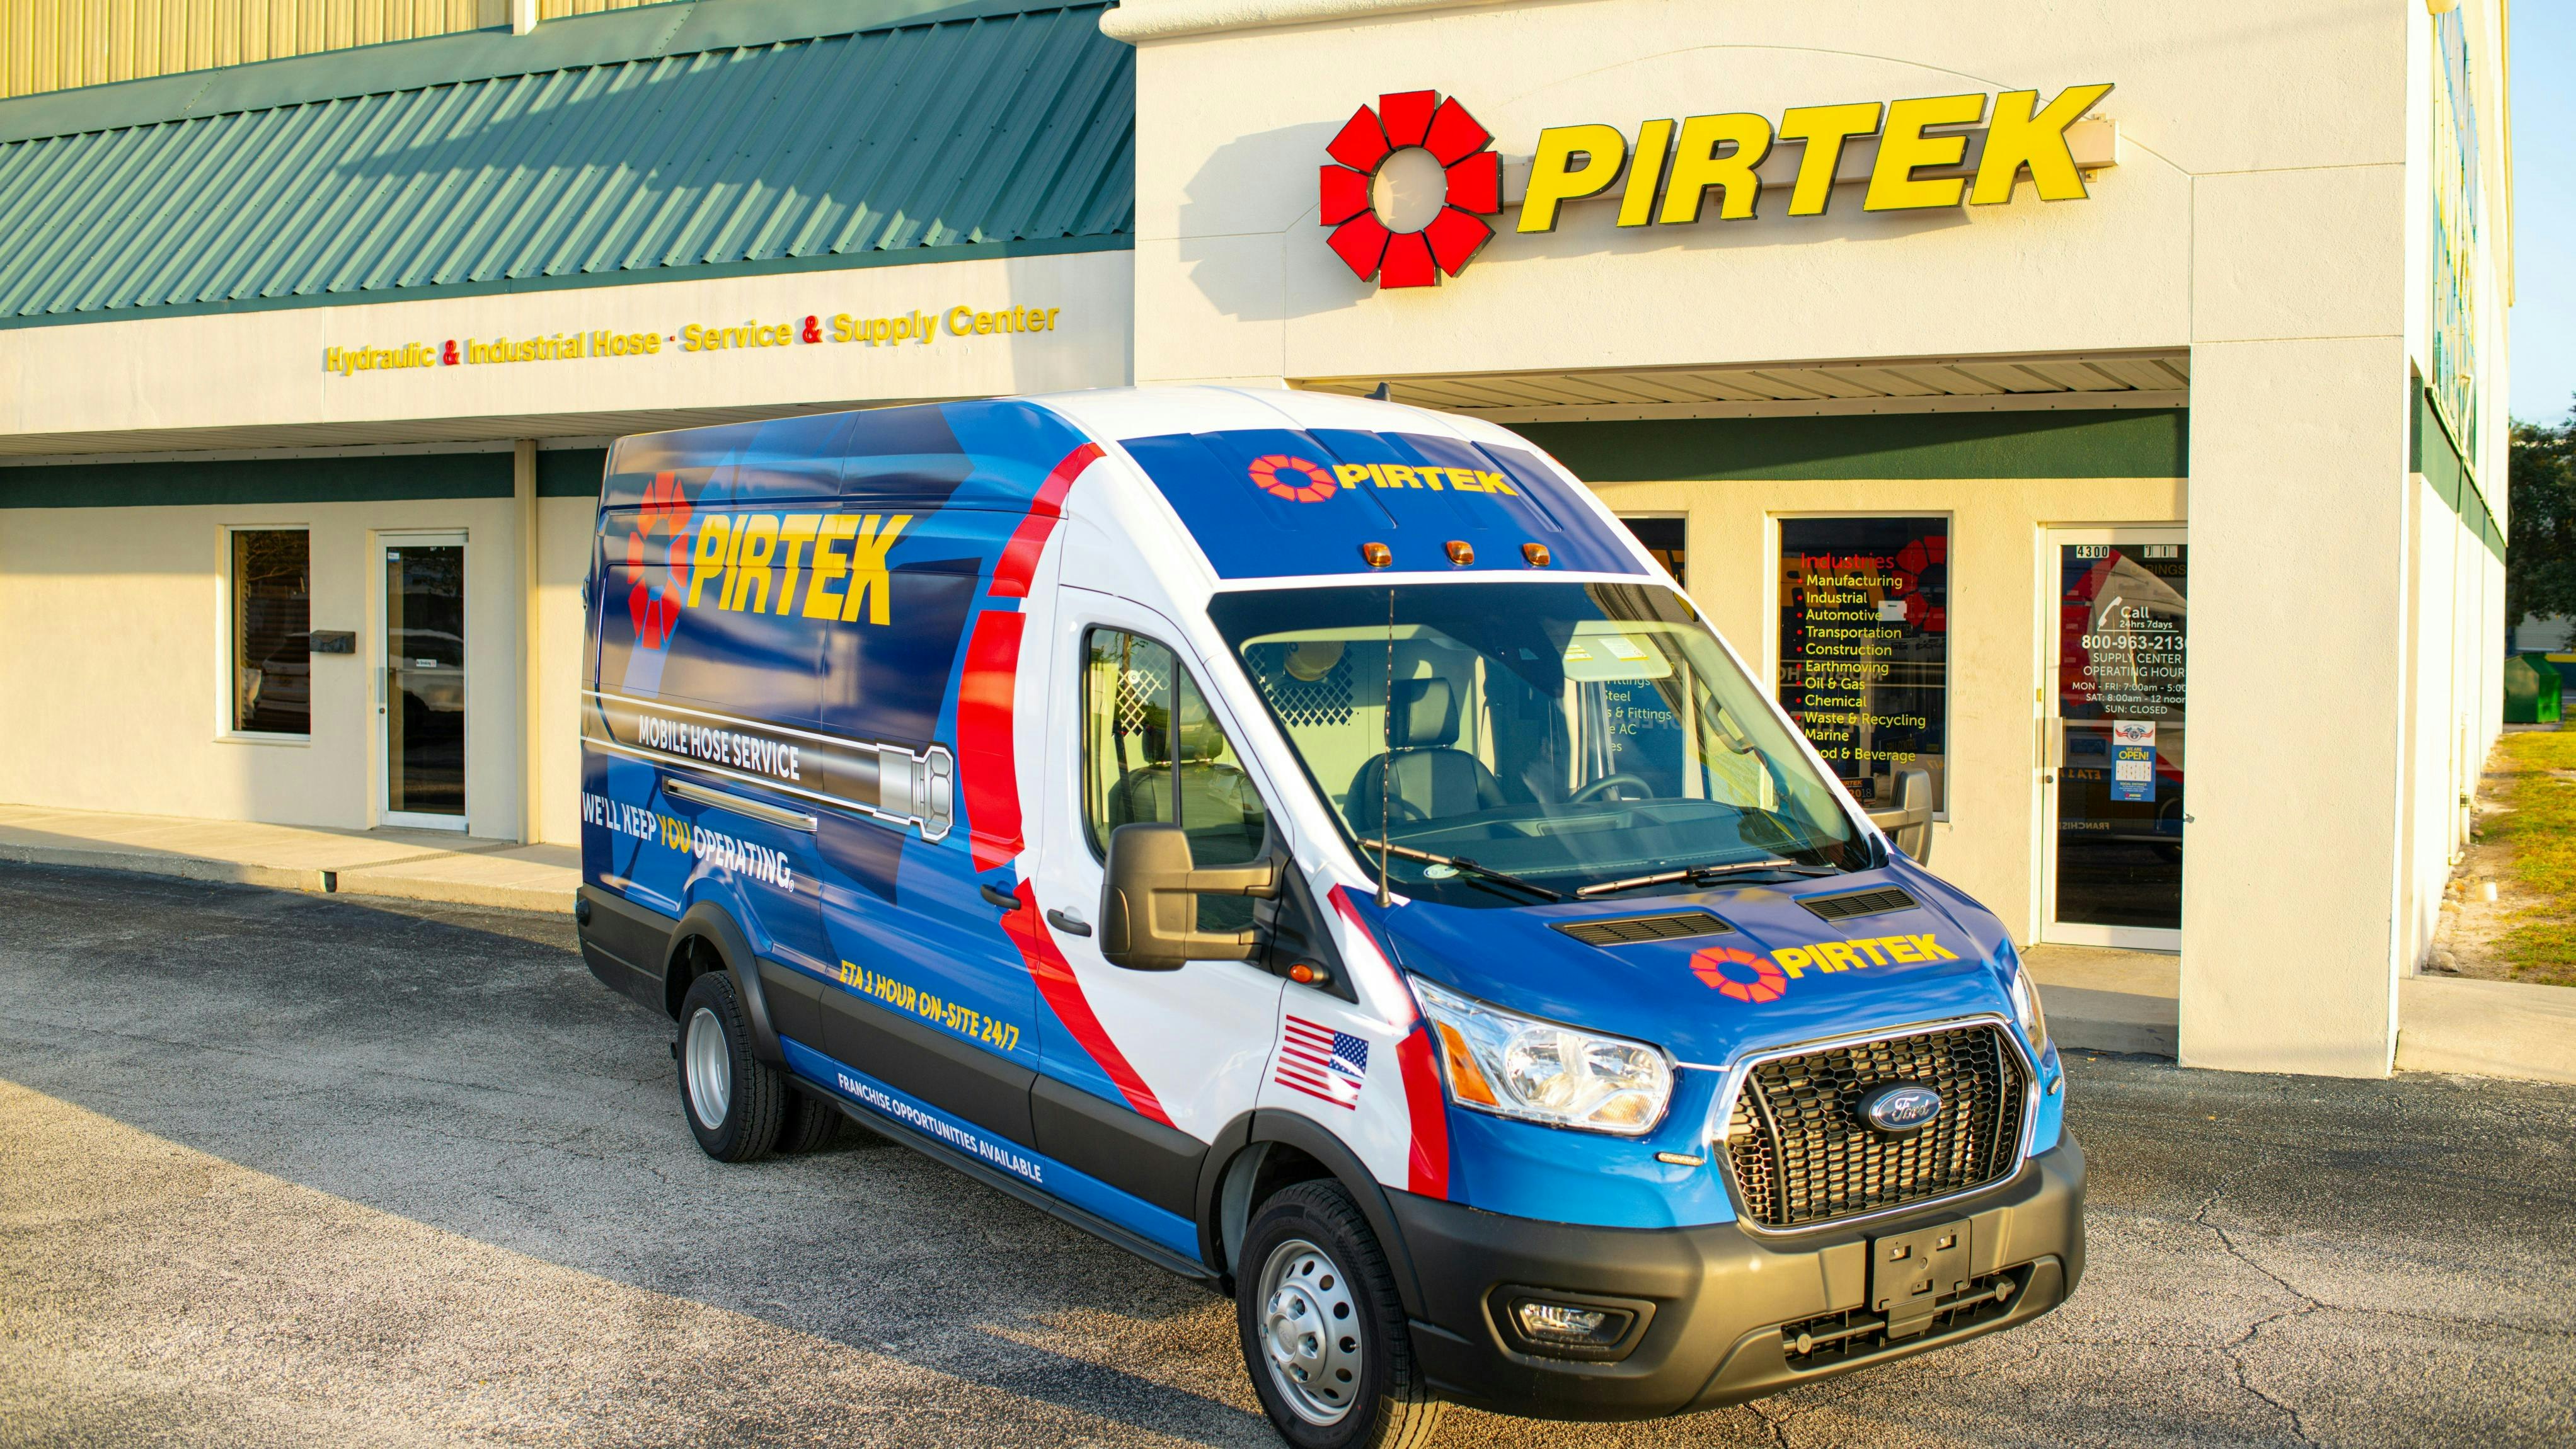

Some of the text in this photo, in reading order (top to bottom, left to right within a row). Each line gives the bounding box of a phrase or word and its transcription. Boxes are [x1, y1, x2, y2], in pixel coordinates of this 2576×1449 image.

[1516, 83, 2115, 234] PIRTEK
[326, 342, 436, 375] Hydraulic
[443, 340, 459, 365] &
[469, 332, 586, 364] Industrial
[592, 329, 660, 357] Hose
[684, 320, 792, 352] Service
[802, 315, 823, 343] &
[834, 309, 939, 346] Supply
[949, 305, 1059, 336] Center
[1332, 464, 1519, 496] PIRTEK
[2078, 546, 2108, 557] 4300
[1801, 552, 1895, 569] Industries
[687, 514, 913, 626] PIRTEK
[1807, 575, 1902, 589] Manufacturing
[1807, 592, 1868, 604] Industrial
[1806, 609, 1883, 621] Automotive
[2120, 606, 2149, 619] Call
[2119, 620, 2173, 630] 24hrs 7days
[1805, 626, 1902, 640] Transportation
[1805, 643, 1892, 656] Construction
[2081, 635, 2187, 650] 800-963-213
[2093, 653, 2182, 663] SUPPLY CENTER
[1806, 660, 1889, 675] Earthmoving
[2083, 666, 2148, 677] OPERATING
[1805, 677, 1865, 690] Oil & Gas
[2073, 682, 2095, 690] MON
[2105, 683, 2121, 691] FRI:
[2124, 683, 2157, 692] 7:00am
[1805, 694, 1867, 707] Chemical
[2086, 694, 2105, 702] SAT:
[2107, 694, 2141, 702] 8:00am
[1616, 707, 1623, 718] &
[1628, 707, 1672, 722] Fittings
[2130, 706, 2168, 714] CLOSED
[1805, 711, 1844, 724] Waste
[1848, 713, 1858, 724] &
[1862, 713, 1926, 728] Recycling
[1619, 724, 1637, 735] AC
[1805, 729, 1849, 742] Marine
[638, 714, 800, 781] MOBILE HOSE SERVICE
[1815, 748, 1837, 759] od
[1841, 748, 1851, 759] &
[1855, 750, 1916, 764] Beverage
[2119, 750, 2149, 760] OPEN!
[582, 791, 621, 832] WE'LL
[621, 802, 657, 841] KEEP
[657, 814, 691, 854] YOU
[1770, 934, 1959, 980] PIRTEK
[839, 959, 1020, 1051] ETA 1 HOUR ON-SITE 24/7
[1892, 1095, 1929, 1121] Ford
[838, 1072, 1043, 1183] FRANCHISE OPPORTUNITIES AVAILABLE
